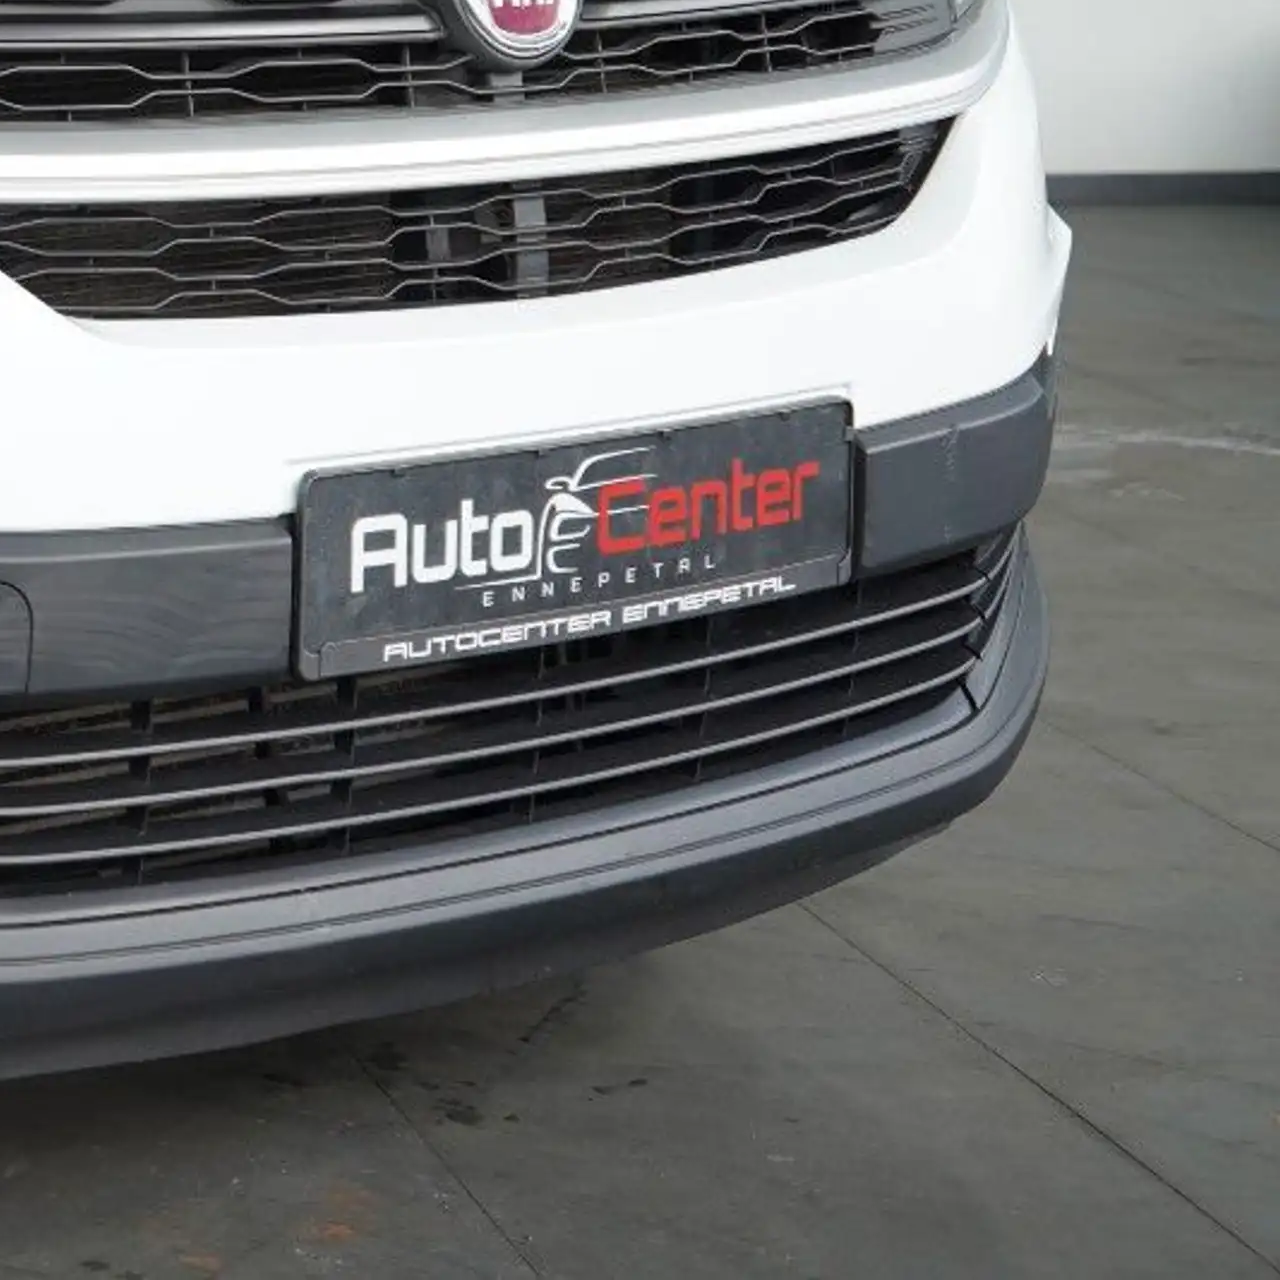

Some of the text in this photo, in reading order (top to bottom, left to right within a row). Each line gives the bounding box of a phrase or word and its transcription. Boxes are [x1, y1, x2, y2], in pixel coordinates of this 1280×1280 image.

[350, 456, 821, 595] Auto Center
[481, 554, 717, 608] ENNEPETAL
